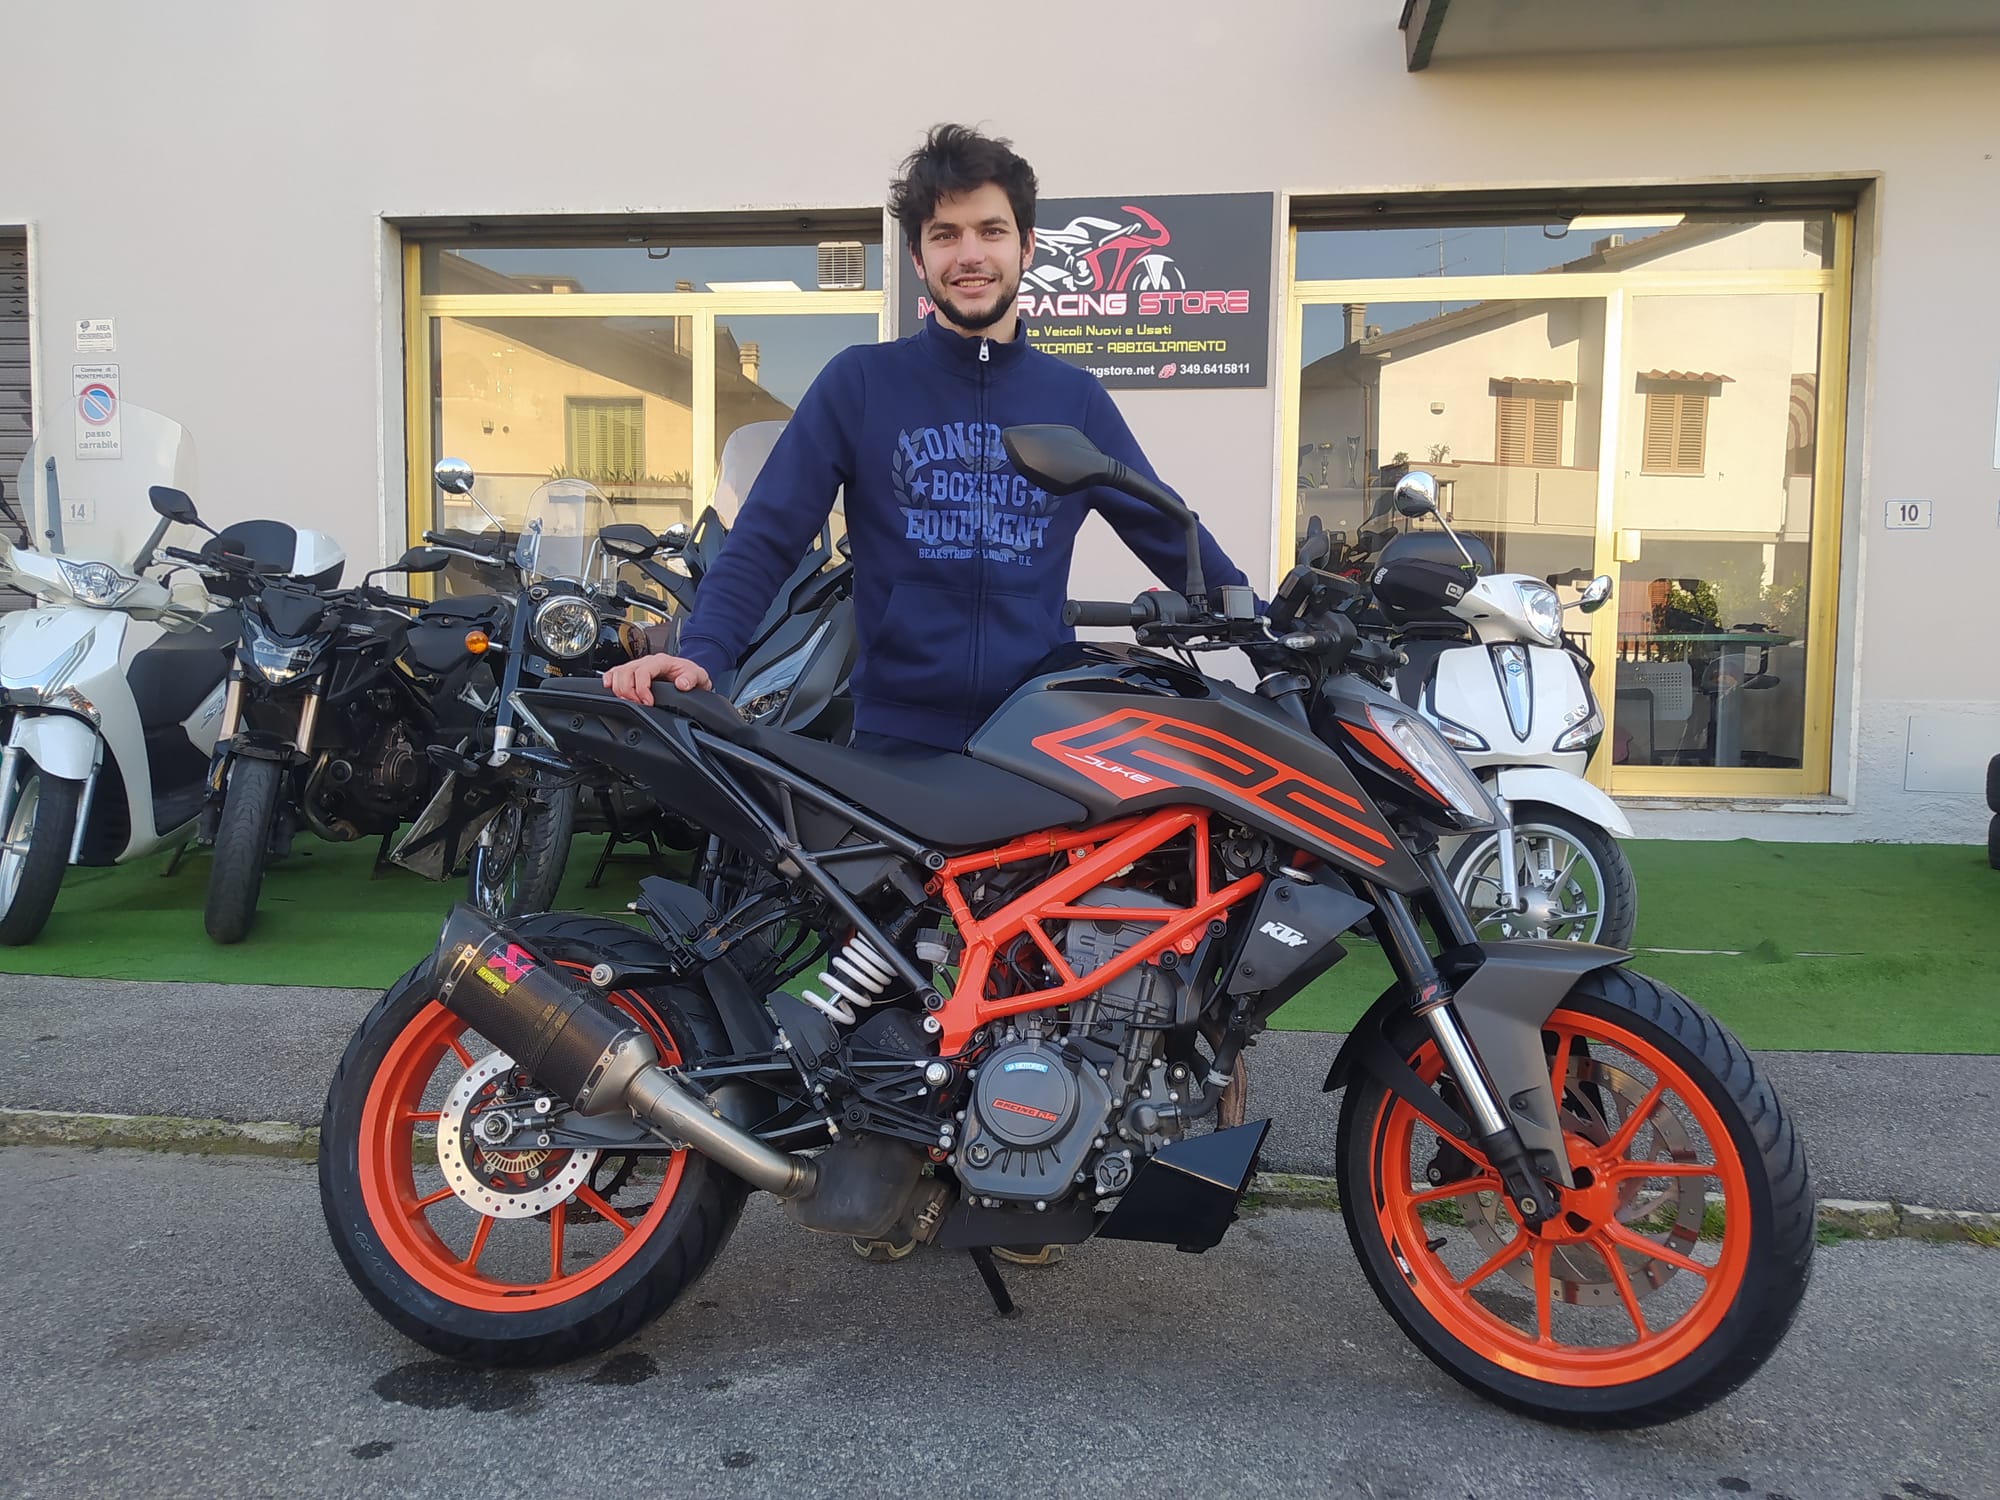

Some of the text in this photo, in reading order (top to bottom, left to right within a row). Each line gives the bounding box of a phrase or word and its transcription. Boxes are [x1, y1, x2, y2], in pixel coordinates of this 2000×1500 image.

[1016, 293, 1128, 318] RACING
[1138, 290, 1250, 316] STORE
[1026, 324, 1172, 338] ta Veicoli Nuovi e Usati
[1107, 340, 1227, 354] ABBIGLIAMENTO
[1082, 363, 1250, 379] ingstore.net 349.6415811
[85, 430, 112, 439] passo
[78, 440, 119, 449] carrabile
[899, 422, 1008, 470] LONSD
[931, 469, 1028, 507] BOXING
[71, 503, 86, 519] 14
[1900, 504, 1919, 522] 10
[1063, 752, 1153, 784] DUKE
[1259, 921, 1308, 947] KTM
[995, 1101, 1037, 1116] RACING
